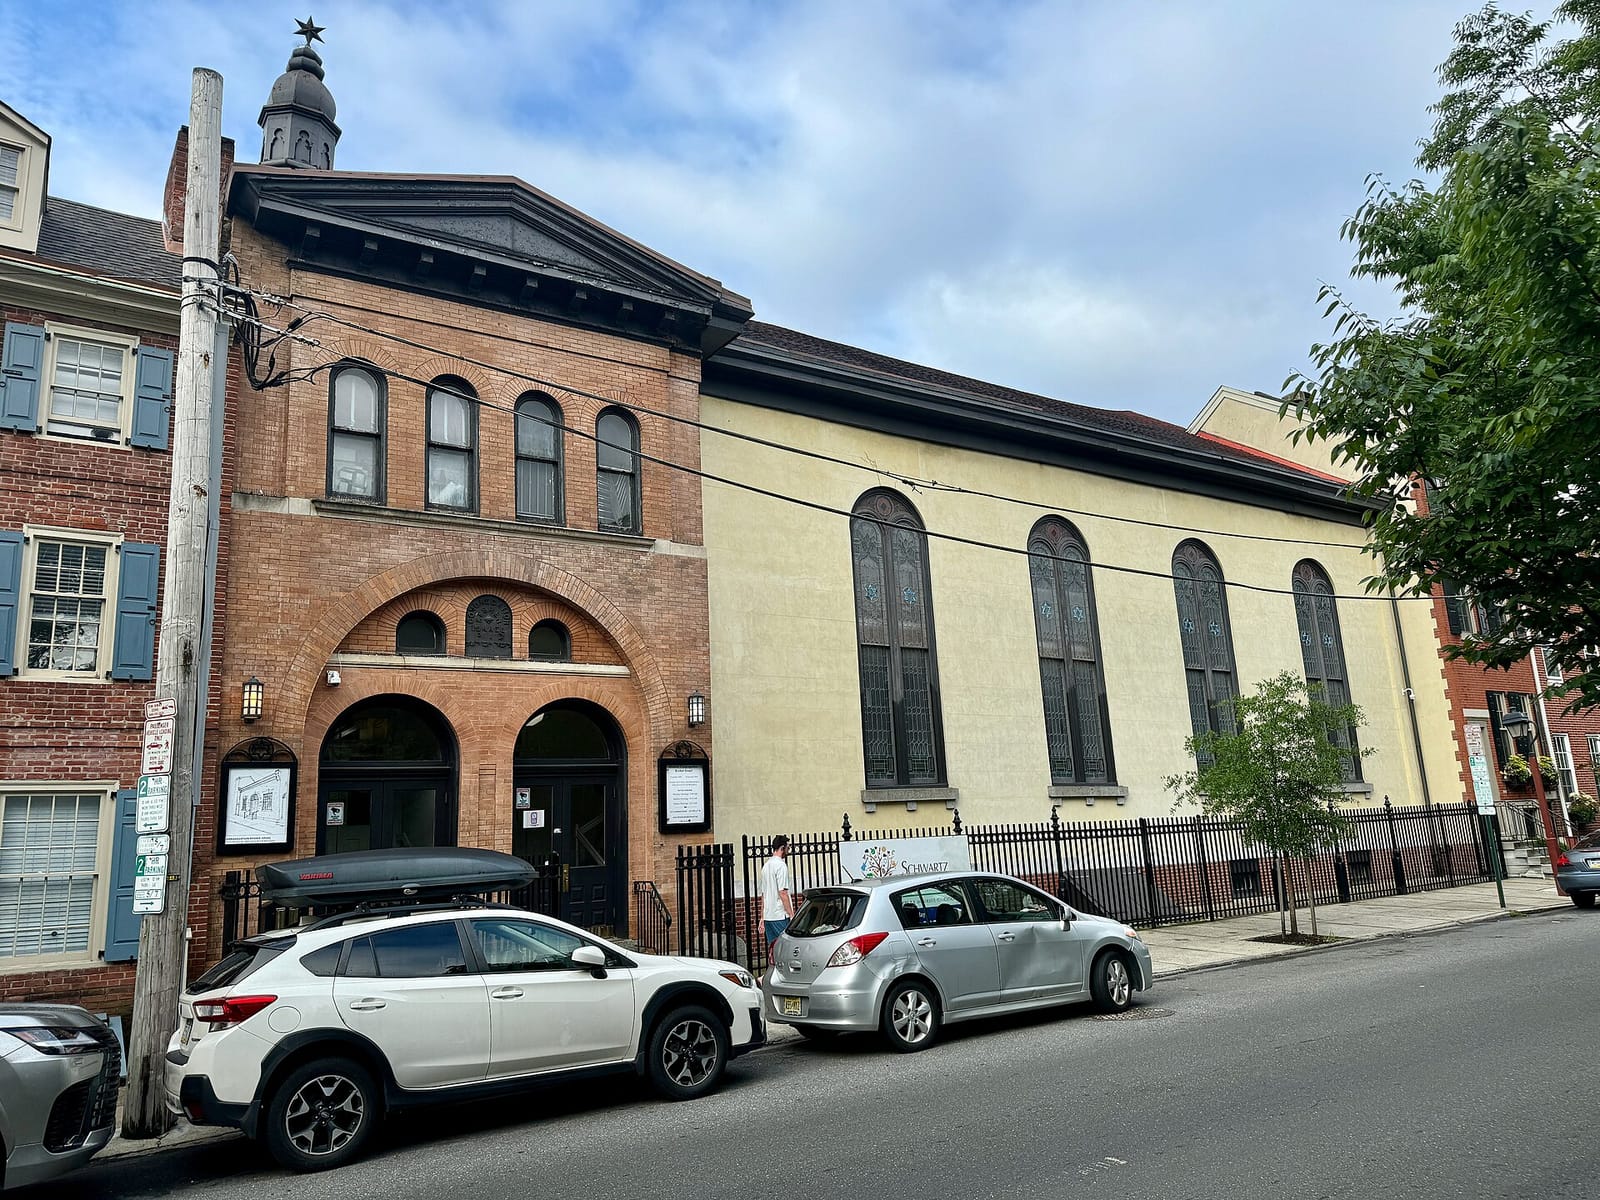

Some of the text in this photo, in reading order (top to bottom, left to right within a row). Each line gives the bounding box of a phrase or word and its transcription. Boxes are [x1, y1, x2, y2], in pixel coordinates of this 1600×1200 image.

[139, 780, 147, 795] 2
[147, 785, 168, 795] PARKING
[137, 858, 144, 873] 2
[145, 865, 165, 874] PARKING
